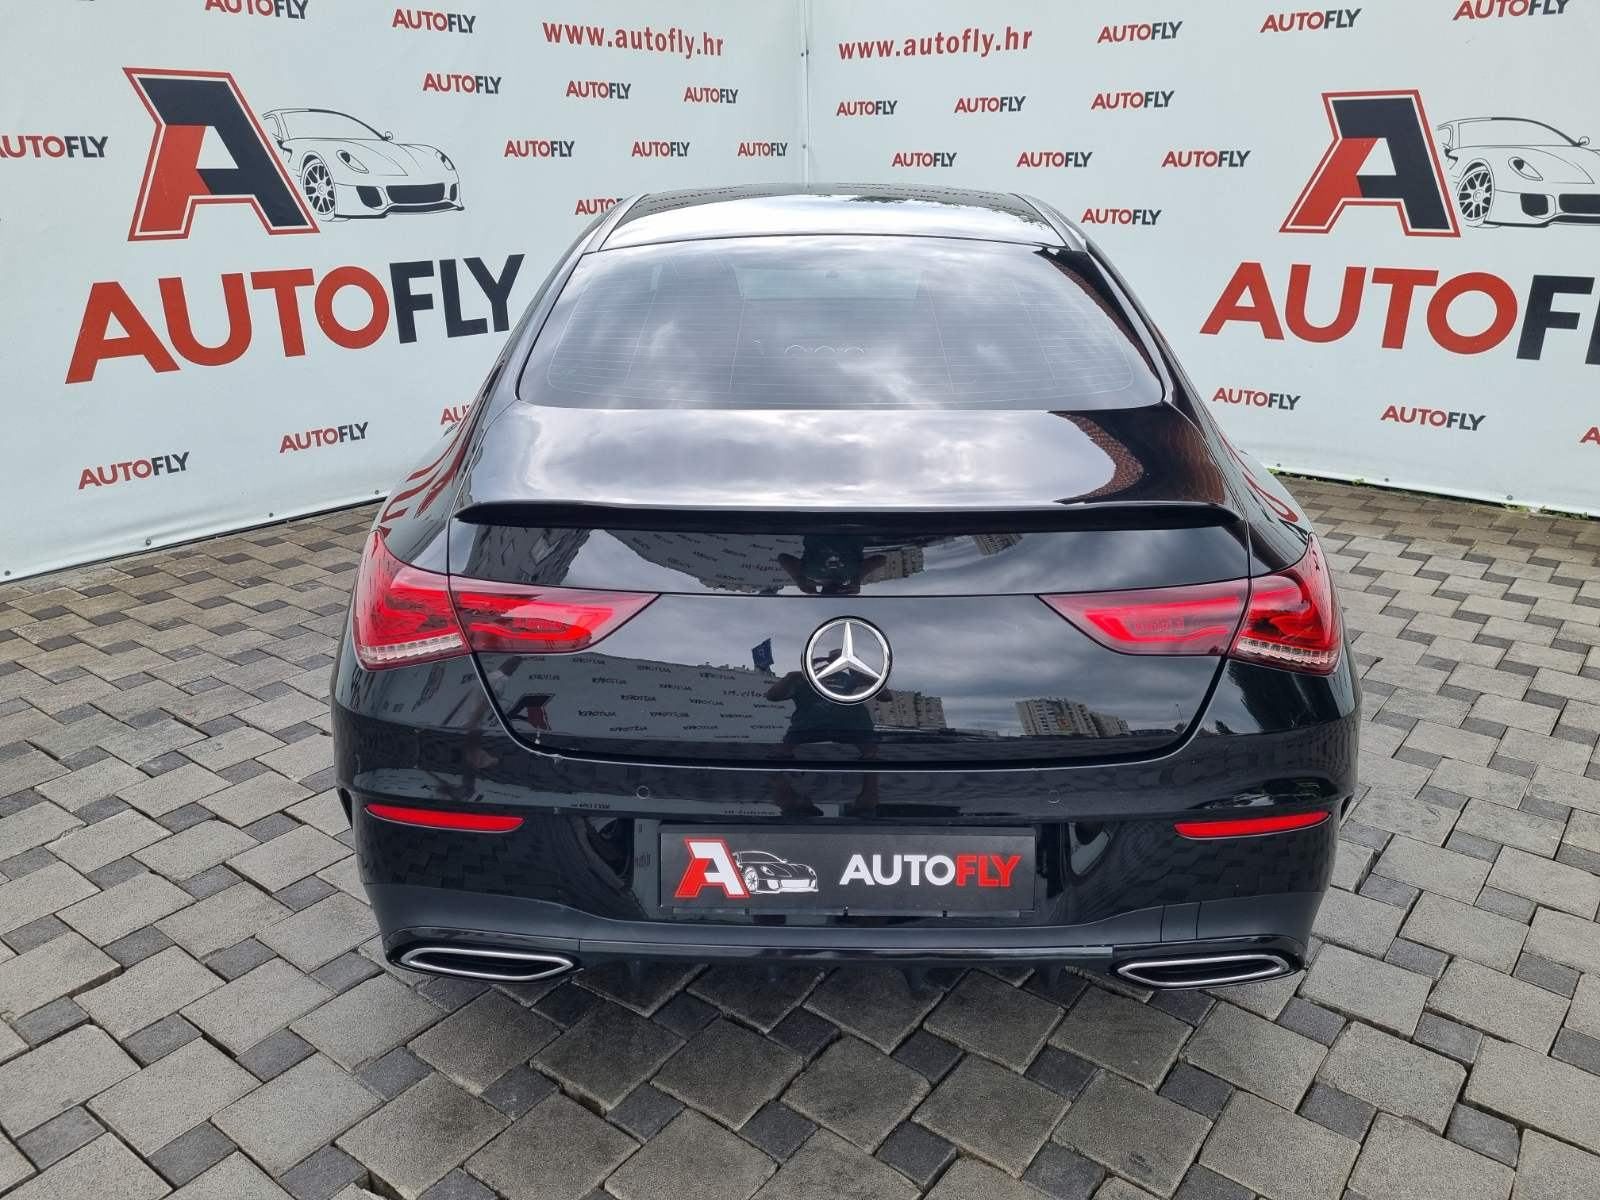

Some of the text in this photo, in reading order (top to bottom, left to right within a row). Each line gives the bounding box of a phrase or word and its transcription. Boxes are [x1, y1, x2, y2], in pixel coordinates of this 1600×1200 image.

[204, 0, 309, 20] AUTOFLY
[1452, 0, 1570, 21] AUTOFLY
[392, 8, 477, 34] AUTOFLY
[1259, 7, 1362, 34] AUTOFLY
[542, 22, 724, 60] www.autofly.hr
[1097, 20, 1183, 44] AUTOFLY
[838, 26, 1033, 60] www.autofly.hr
[422, 72, 502, 95] AUTOFLY
[565, 80, 632, 100] AUTOFLY
[683, 86, 739, 104] AUTOFLY
[954, 95, 1027, 114] AUTOFLY
[1090, 90, 1175, 110] AUTOFLY
[836, 99, 898, 117] AUTOFLY
[503, 140, 575, 158] AUTOFLY
[631, 141, 691, 158] AUTOFLY
[737, 142, 789, 157] AUTOFLY
[1161, 150, 1252, 168] AUTOFLY
[891, 151, 958, 168] AUTOFLY
[1016, 151, 1094, 168] AUTOFLY
[574, 197, 624, 217] AUTO
[1080, 208, 1162, 226] AUTOFLY
[64, 253, 526, 385] AUTOFLY
[1199, 261, 1600, 366] AUTOF
[1211, 387, 1302, 412] AUTOFLY
[1380, 405, 1487, 432] AUTOFLY
[279, 421, 369, 454] AUTOFLY
[78, 450, 190, 490] AUTOFLY
[839, 853, 1022, 888] AUTOFLY
